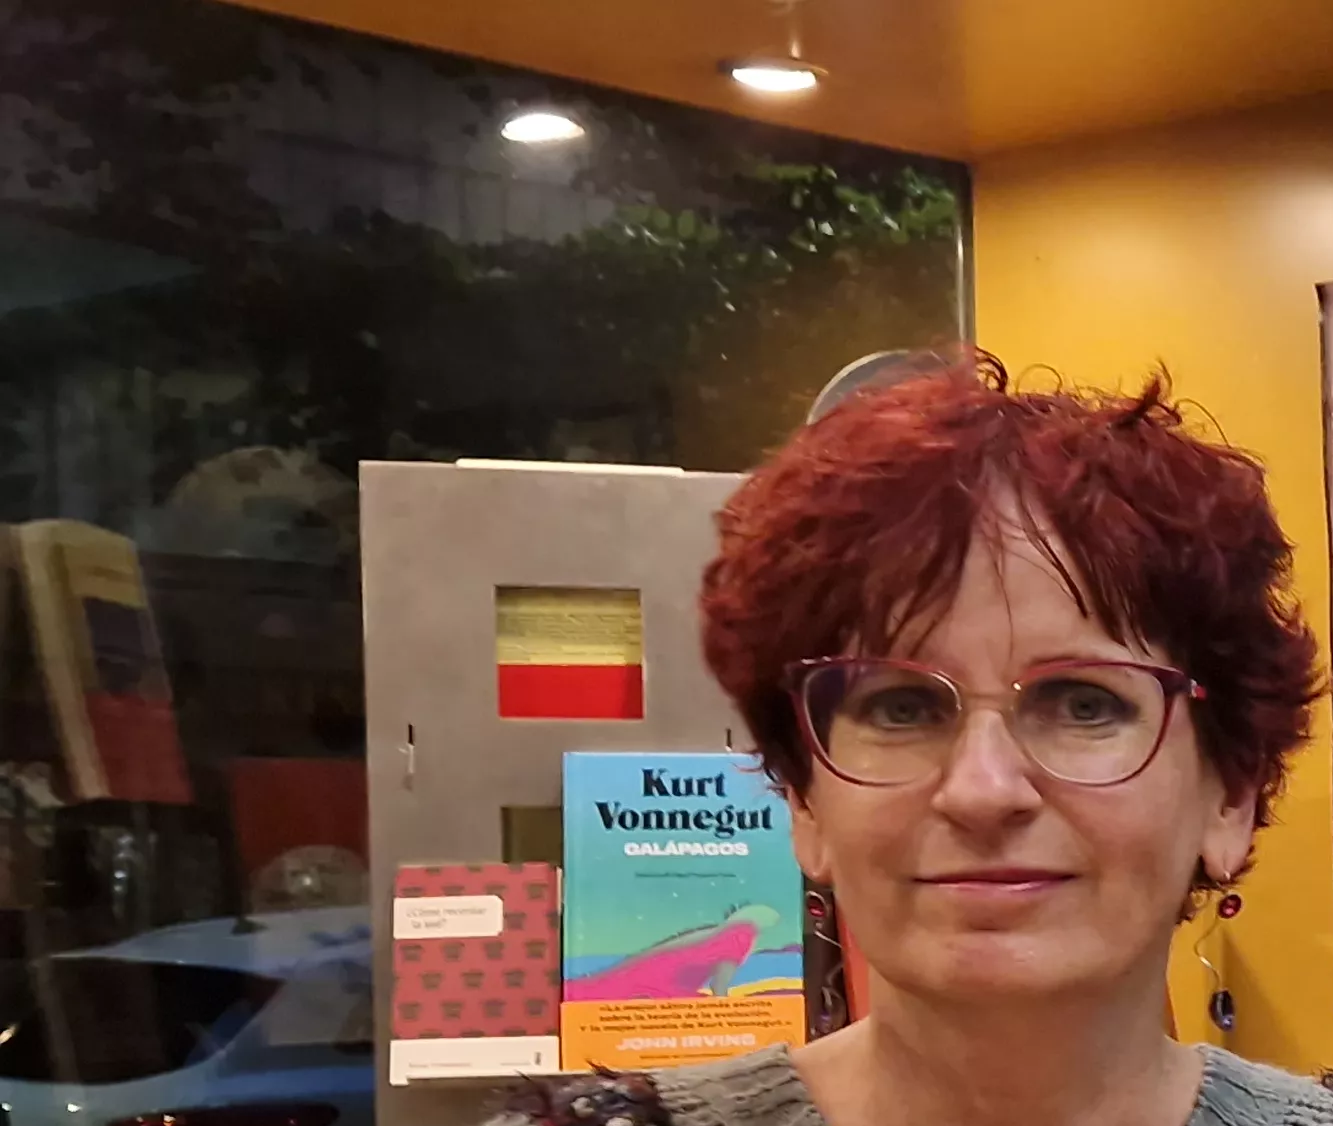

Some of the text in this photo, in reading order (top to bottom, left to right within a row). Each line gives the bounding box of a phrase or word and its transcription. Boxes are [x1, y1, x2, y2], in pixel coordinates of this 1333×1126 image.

[641, 766, 727, 798] Kurt
[595, 800, 774, 839] Vonnegut
[623, 836, 750, 857] GALÁPAGOS
[616, 1033, 756, 1051] JOHN IRVING
